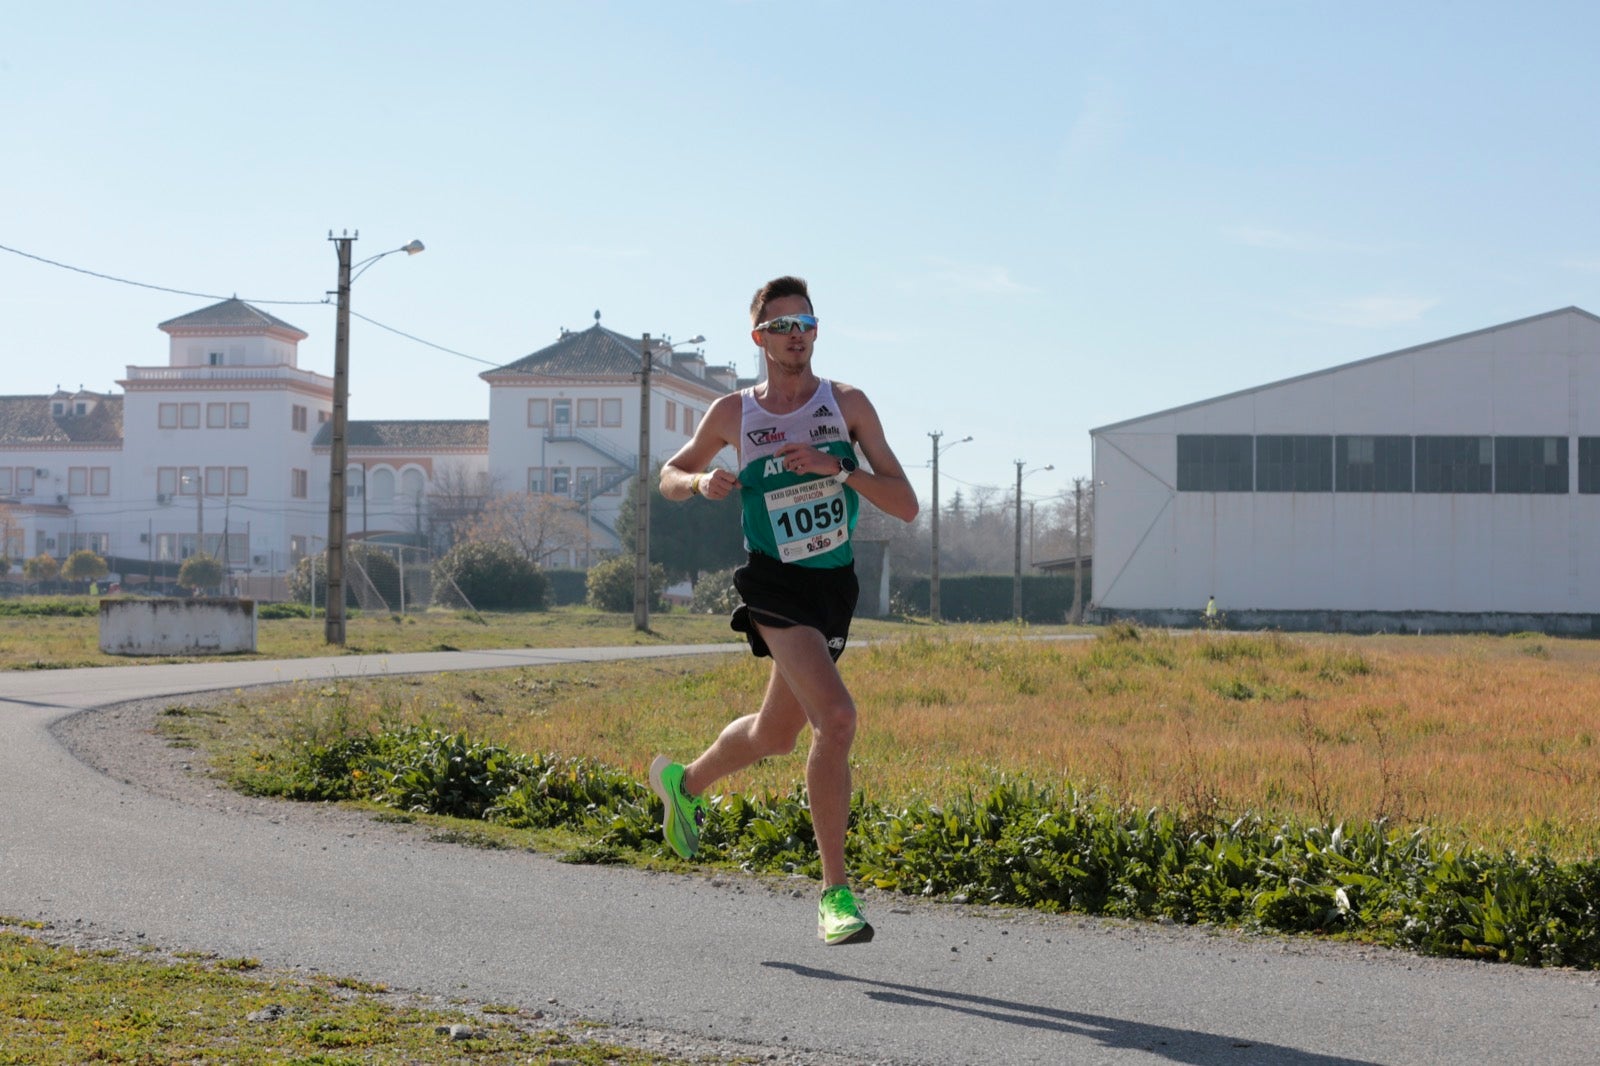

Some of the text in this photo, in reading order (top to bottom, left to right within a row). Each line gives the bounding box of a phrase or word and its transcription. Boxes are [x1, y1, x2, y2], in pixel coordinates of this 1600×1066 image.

[785, 488, 799, 498] GRAN
[799, 484, 818, 494] PREMIO
[818, 481, 826, 489] DE
[777, 498, 844, 538] 1059
